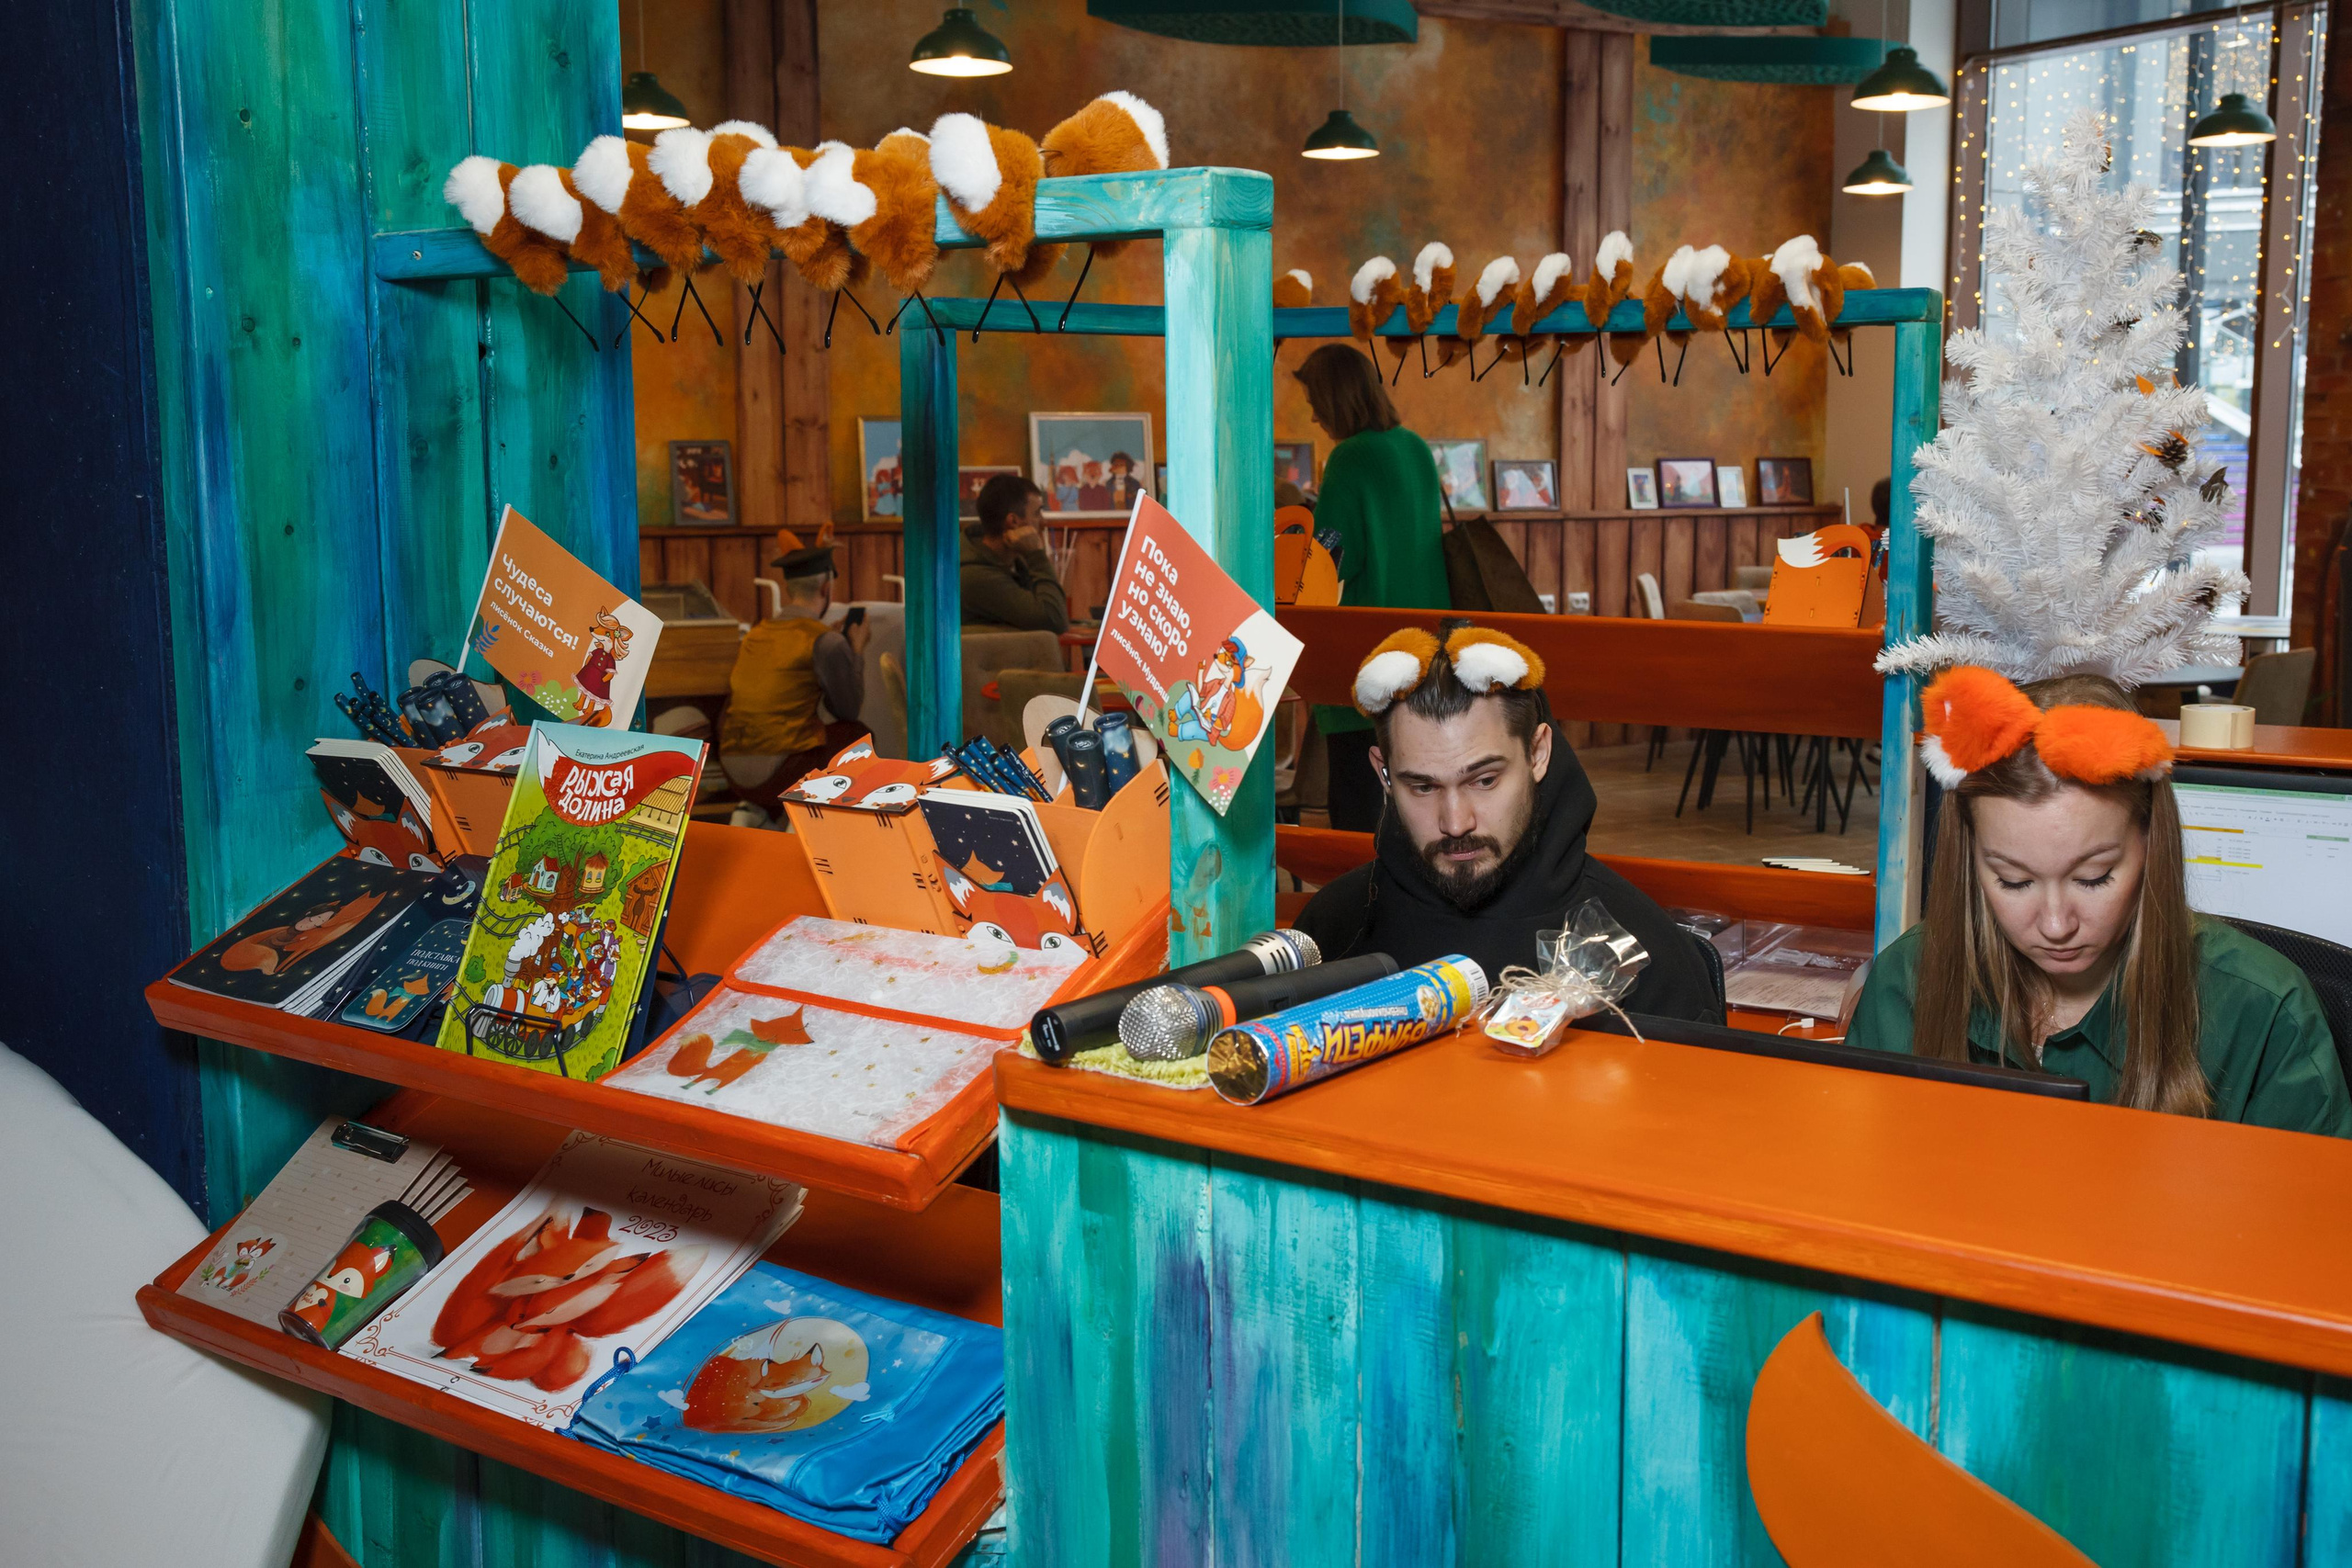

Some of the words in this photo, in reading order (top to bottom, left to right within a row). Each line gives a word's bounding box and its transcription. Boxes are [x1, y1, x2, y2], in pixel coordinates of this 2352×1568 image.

[503, 553, 553, 606] Чудеса
[1141, 535, 1179, 586] Пока
[494, 577, 580, 650] случаются!
[1127, 581, 1148, 606] но
[1148, 604, 1188, 658] скоро
[1134, 559, 1155, 587] не
[1155, 582, 1192, 638] знаю,
[490, 601, 523, 634] лисёнок
[523, 629, 554, 659] Сказка
[1117, 600, 1169, 662] узнаю!
[1110, 627, 1143, 668] лисёнок
[1141, 662, 1170, 704] Мудряш
[575, 749, 605, 761] Екатерина
[605, 743, 645, 760] Андреевская
[410, 949, 461, 964] ПОДСТАВКА
[641, 1157, 695, 1185] Милые
[694, 1177, 739, 1196] лисы
[618, 1214, 680, 1243] 2023
